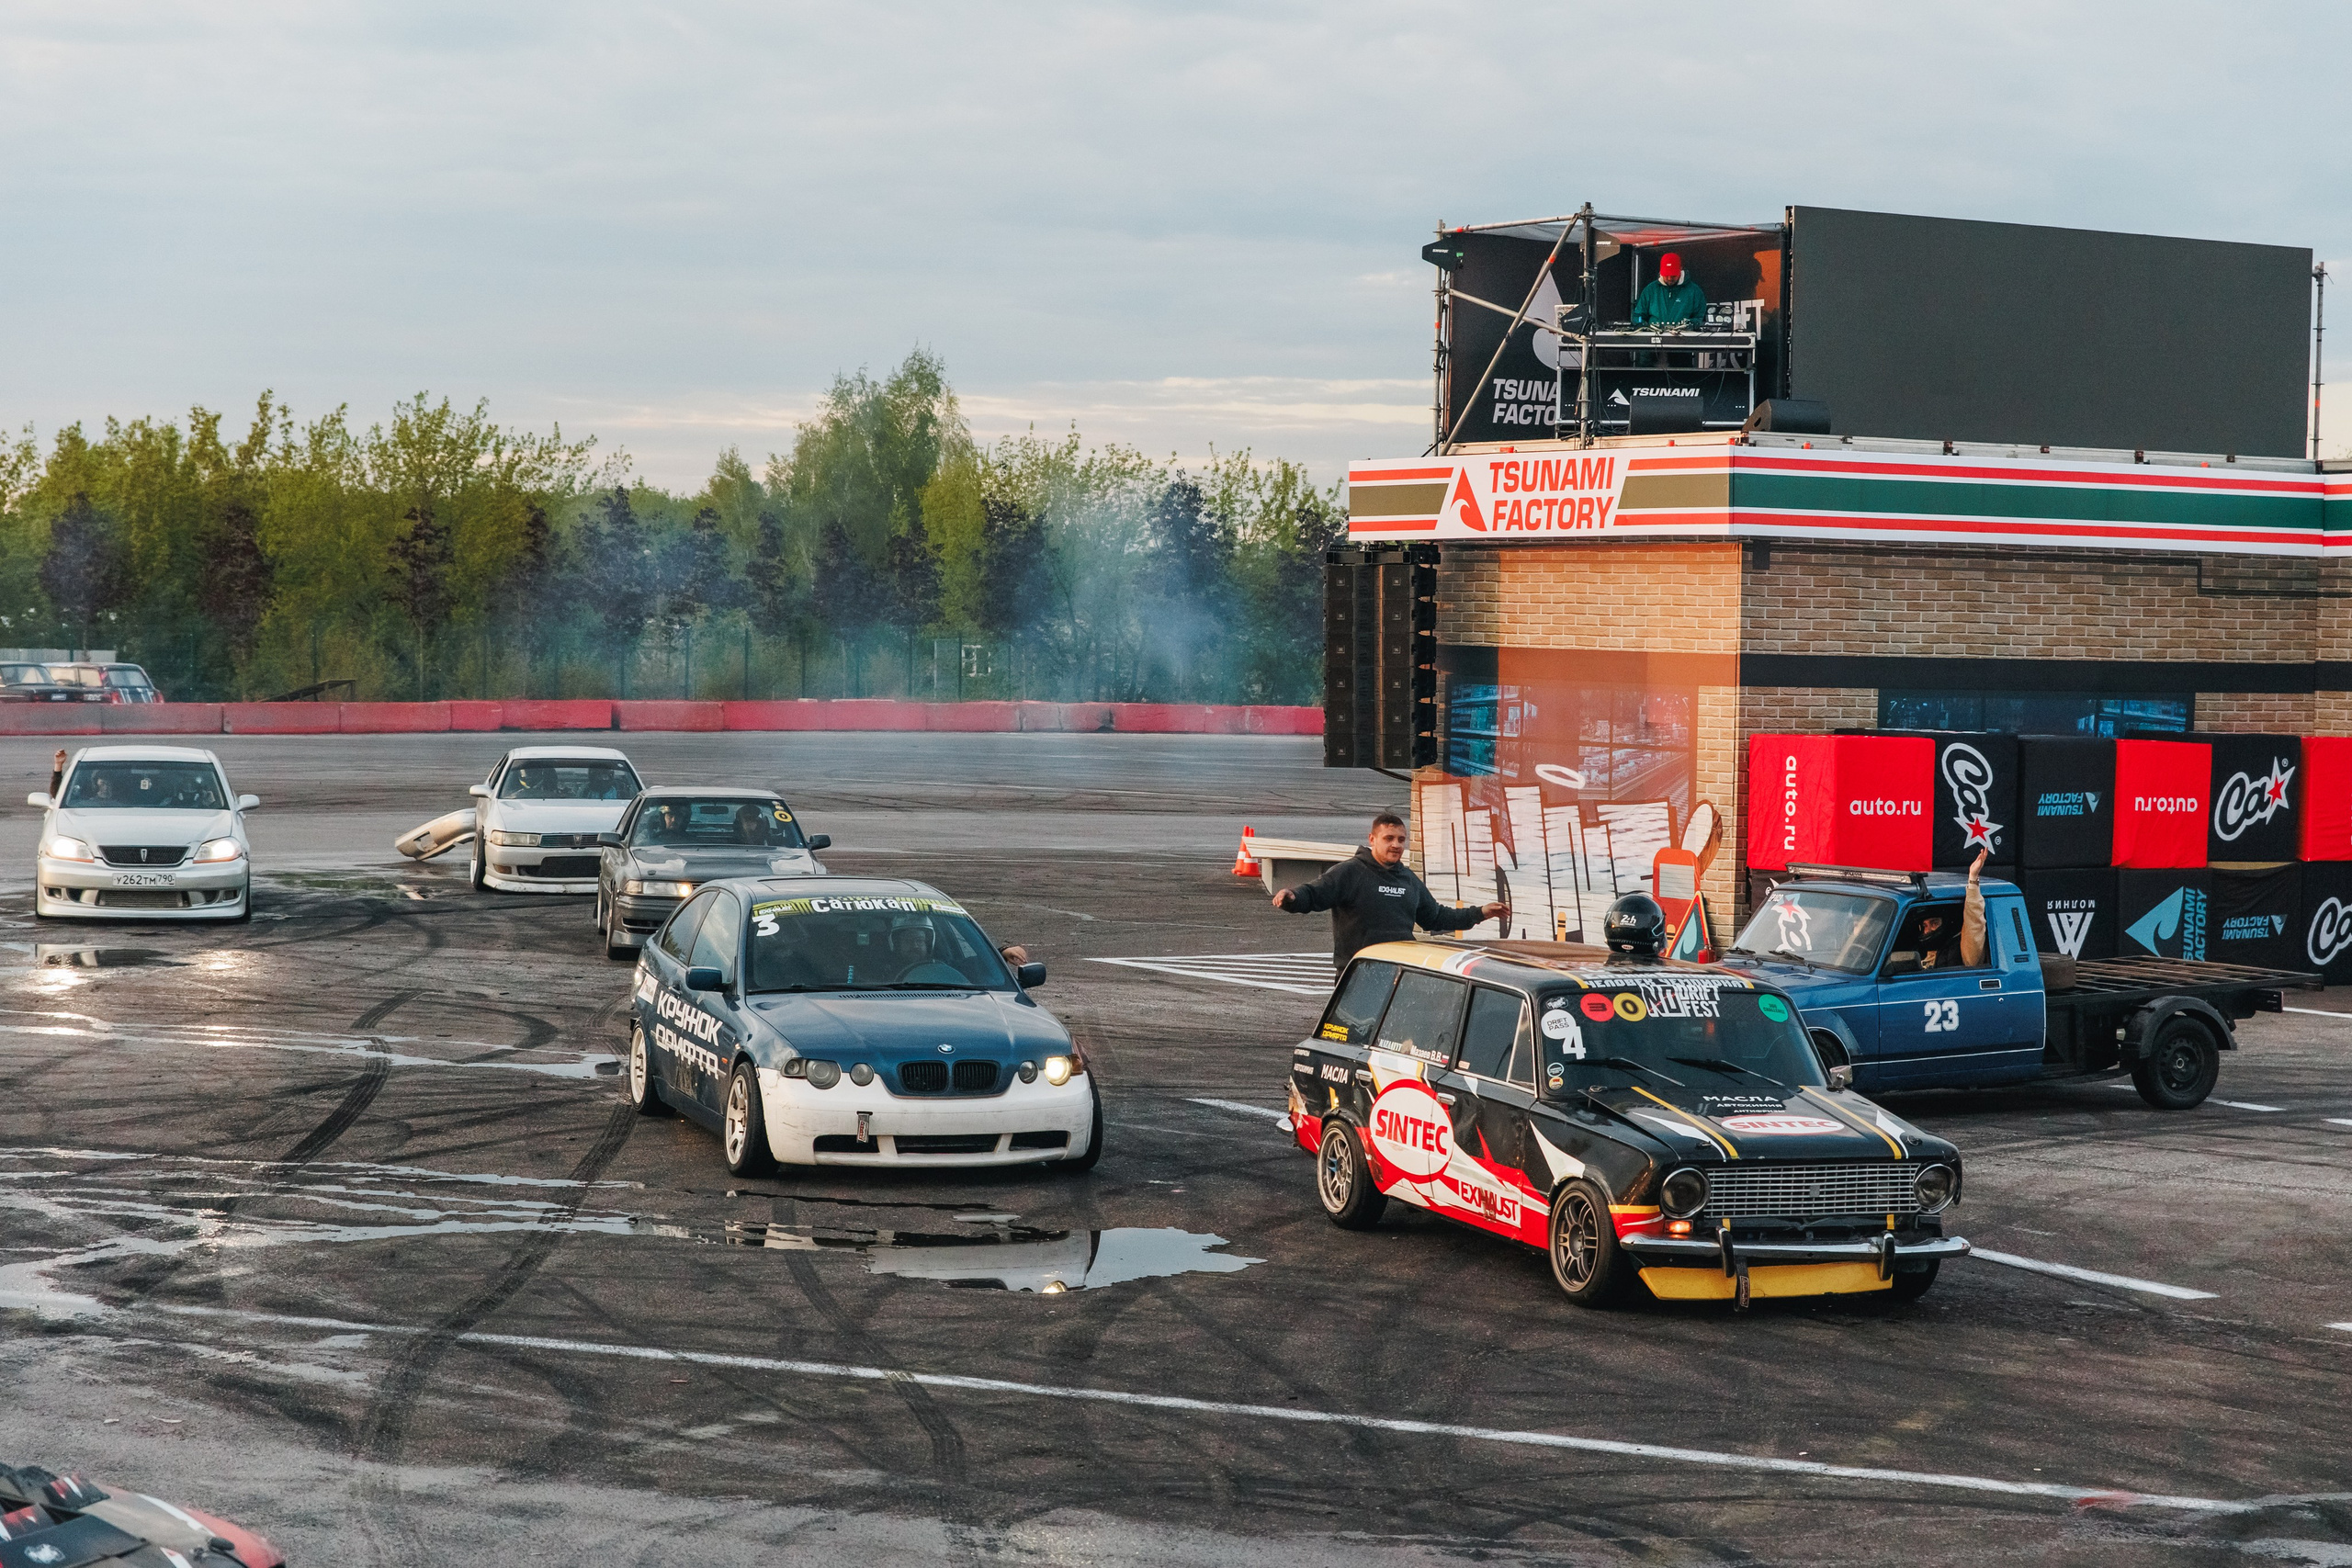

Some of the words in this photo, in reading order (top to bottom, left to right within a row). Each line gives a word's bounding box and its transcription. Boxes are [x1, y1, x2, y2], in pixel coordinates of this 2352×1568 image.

[1493, 378, 1558, 400] TSUNA
[1632, 388, 1700, 397] TSUNAMI
[1492, 403, 1557, 425] FACTO
[1489, 457, 1614, 493] TSUNAMI
[1492, 496, 1614, 532] FACTORY
[1784, 755, 1798, 851] auto.ru
[1849, 797, 1922, 816] auto.ru
[2038, 793, 2084, 805] FACTORY
[2134, 796, 2198, 813] auto.ru
[2037, 806, 2084, 817] TSUNAMI
[157, 874, 173, 883] 790
[1379, 886, 1406, 895] EXHAUST
[2047, 899, 2096, 909] МОЛНИЯ
[752, 914, 780, 937] 3
[2183, 887, 2196, 961] SUNAMI
[2195, 887, 2207, 962] ACTORY
[2222, 915, 2269, 928] FACTORY
[2222, 929, 2269, 940] TSUNAMI
[656, 990, 723, 1046] КРУЖОК
[1682, 1001, 1720, 1017] FEST
[1924, 999, 1959, 1032] 23
[1323, 1022, 1349, 1034] КРУЖОК
[1547, 1017, 1567, 1026] DRIFT
[1548, 1022, 1569, 1031] PASS
[651, 1023, 725, 1079] ДРИФТА
[1410, 1044, 1430, 1059] Мазаев
[1563, 1026, 1587, 1059] 4
[1320, 1064, 1349, 1084] МАСЛА
[1375, 1109, 1448, 1156] SINTEC
[1729, 1121, 1838, 1129] SINTEC
[1461, 1180, 1519, 1222] EXHAUST
